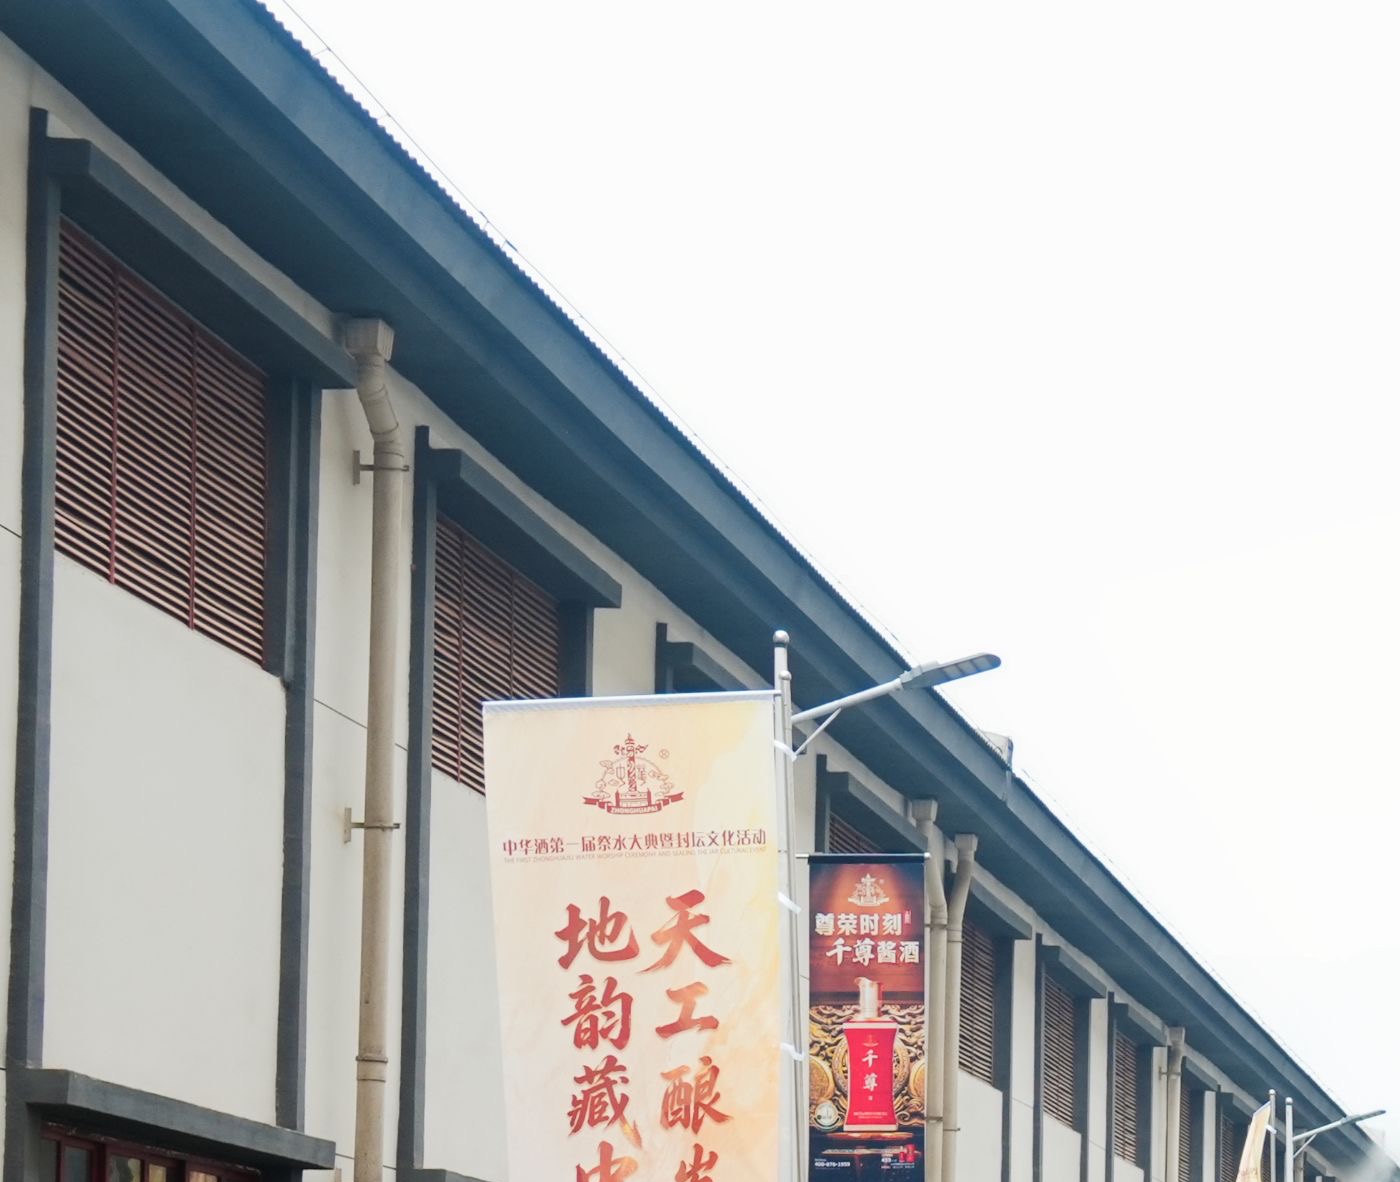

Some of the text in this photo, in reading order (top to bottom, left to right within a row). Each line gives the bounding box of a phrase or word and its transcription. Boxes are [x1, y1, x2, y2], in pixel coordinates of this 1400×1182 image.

[502, 828, 767, 856] 中华酒第一届祭水大典暨封坛文化活动
[815, 913, 902, 936] 尊荣时刻
[826, 937, 920, 967] 千尊酱酒
[861, 1049, 878, 1092] 千尊
